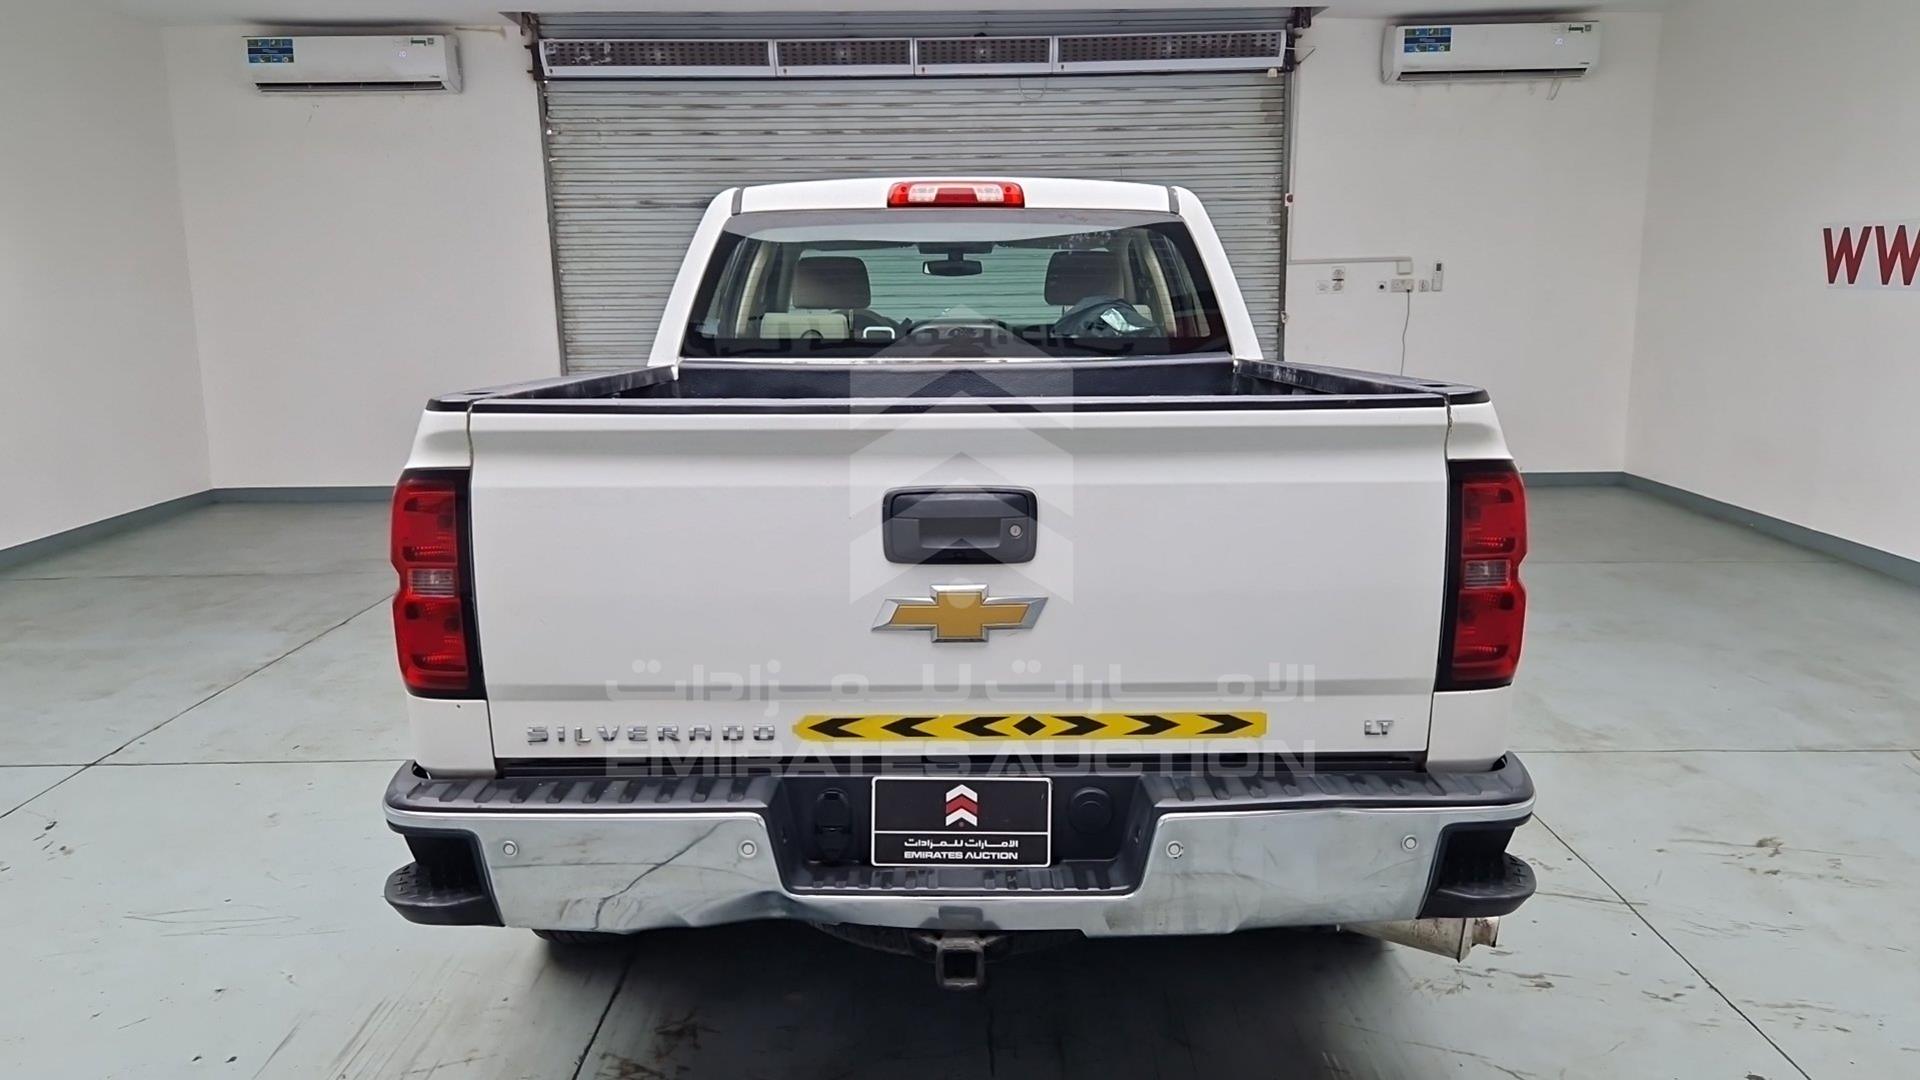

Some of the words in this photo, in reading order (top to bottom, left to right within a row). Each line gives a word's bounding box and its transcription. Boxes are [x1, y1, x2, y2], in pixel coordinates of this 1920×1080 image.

[526, 723, 776, 745] SILVERADO
[1363, 719, 1394, 736] LT
[904, 851, 963, 860] EMIRATES
[964, 851, 1018, 860] AUCTION
